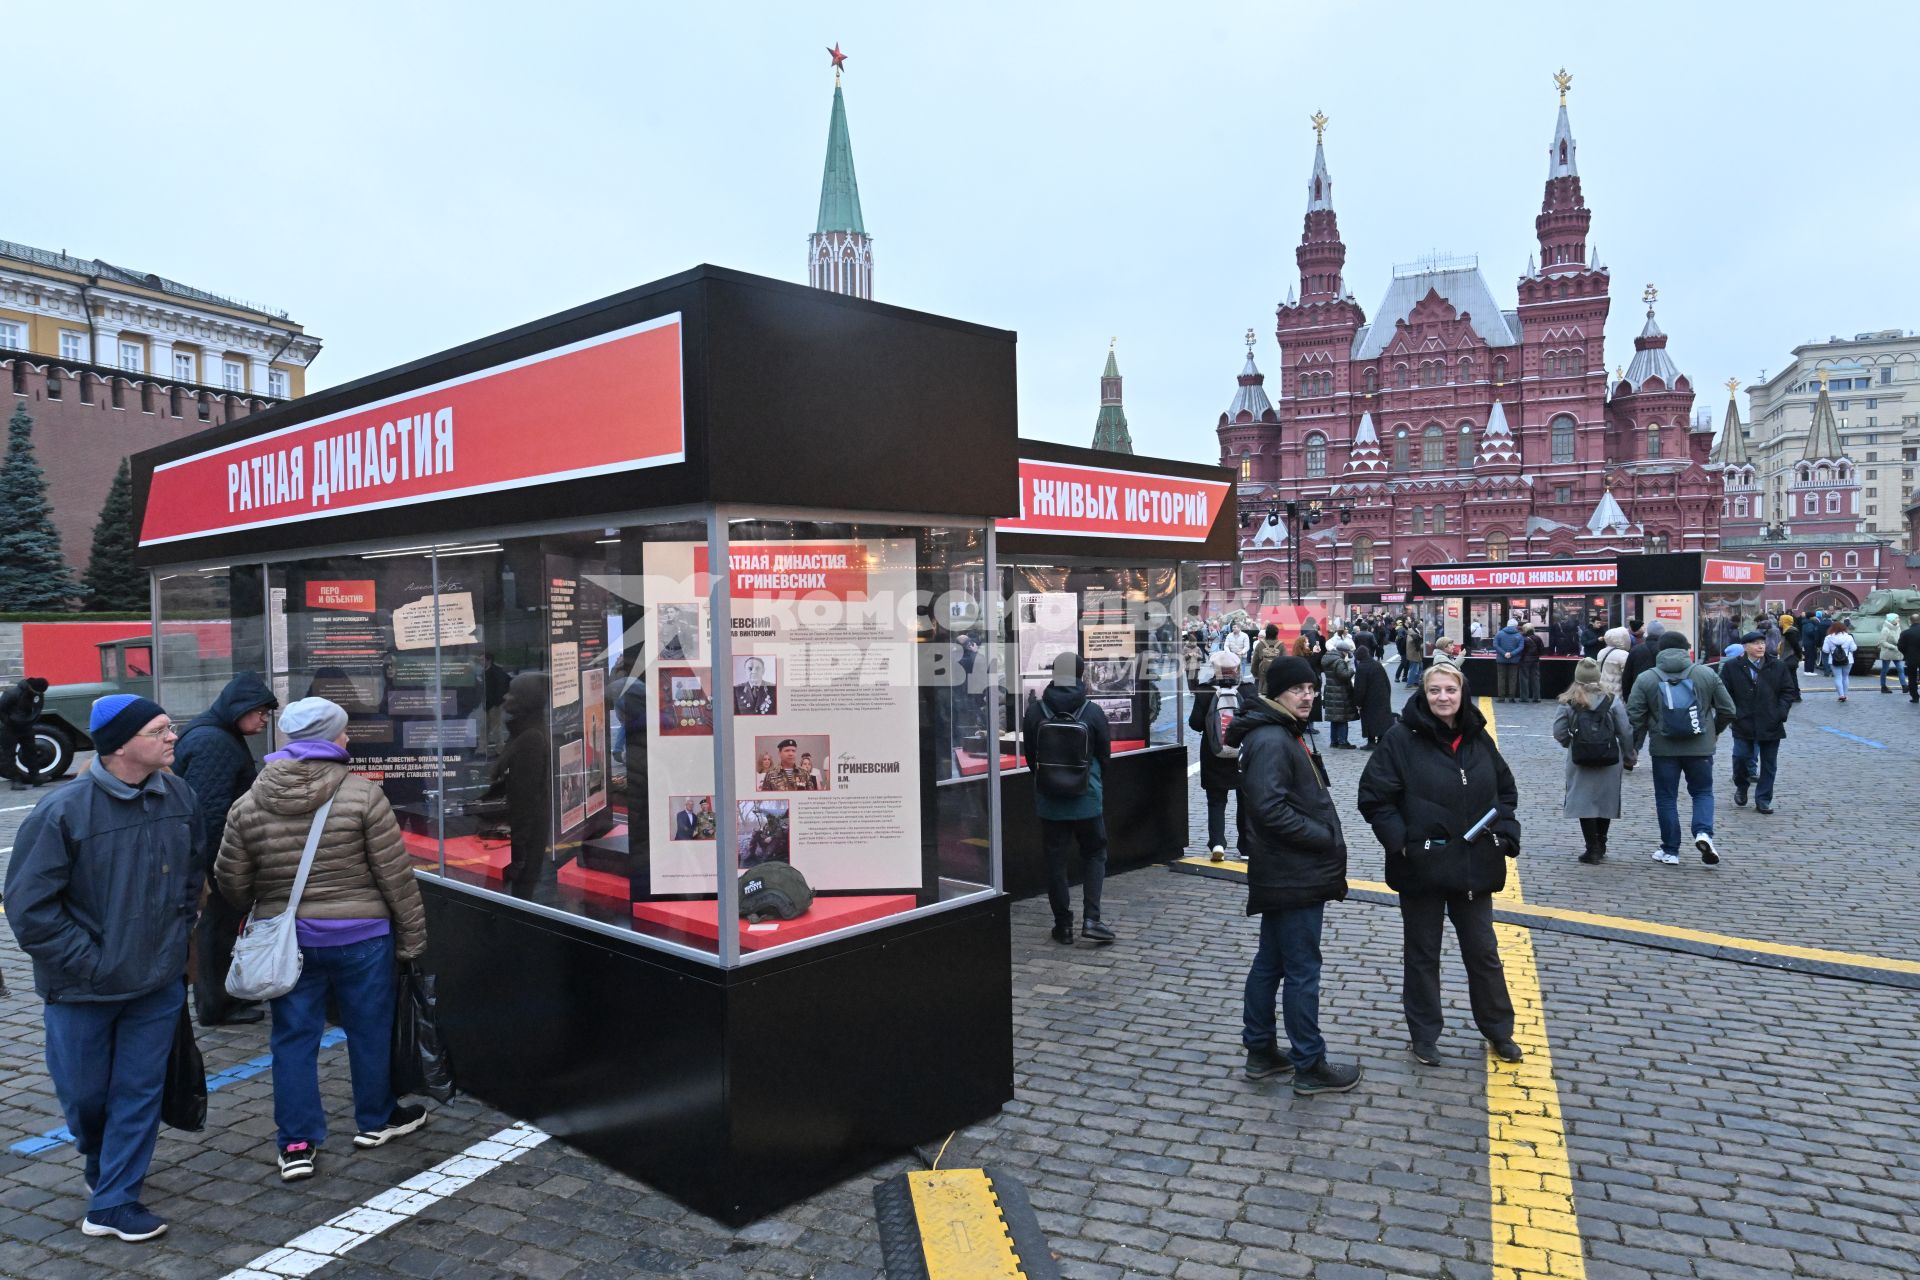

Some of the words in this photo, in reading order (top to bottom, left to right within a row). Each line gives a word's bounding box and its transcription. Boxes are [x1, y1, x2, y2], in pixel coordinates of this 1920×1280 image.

[228, 445, 304, 513] РАТНАЯ
[312, 406, 454, 507] ДИНАСТИЯ
[1033, 478, 1119, 520] ЖИВЫХ
[1124, 487, 1208, 527] ИСТОРИЙ
[773, 553, 848, 573] ДИНАСТИЯ
[737, 573, 826, 589] ГРИНЕВСКИХ
[1431, 574, 1475, 586] МОСКВА
[1489, 572, 1526, 585] ГОРОД
[1528, 570, 1573, 583] ЖИВЫХ
[320, 586, 340, 595] ПЕРО
[318, 595, 324, 603] И
[325, 595, 364, 604] ОБЪЕКТИВ
[739, 630, 776, 638] ВИКТОРОВИЧ
[368, 756, 383, 764] ГОДА
[838, 761, 900, 774] ГРИНЕВСКИЙ
[384, 771, 405, 779] ВСКОРЕ
